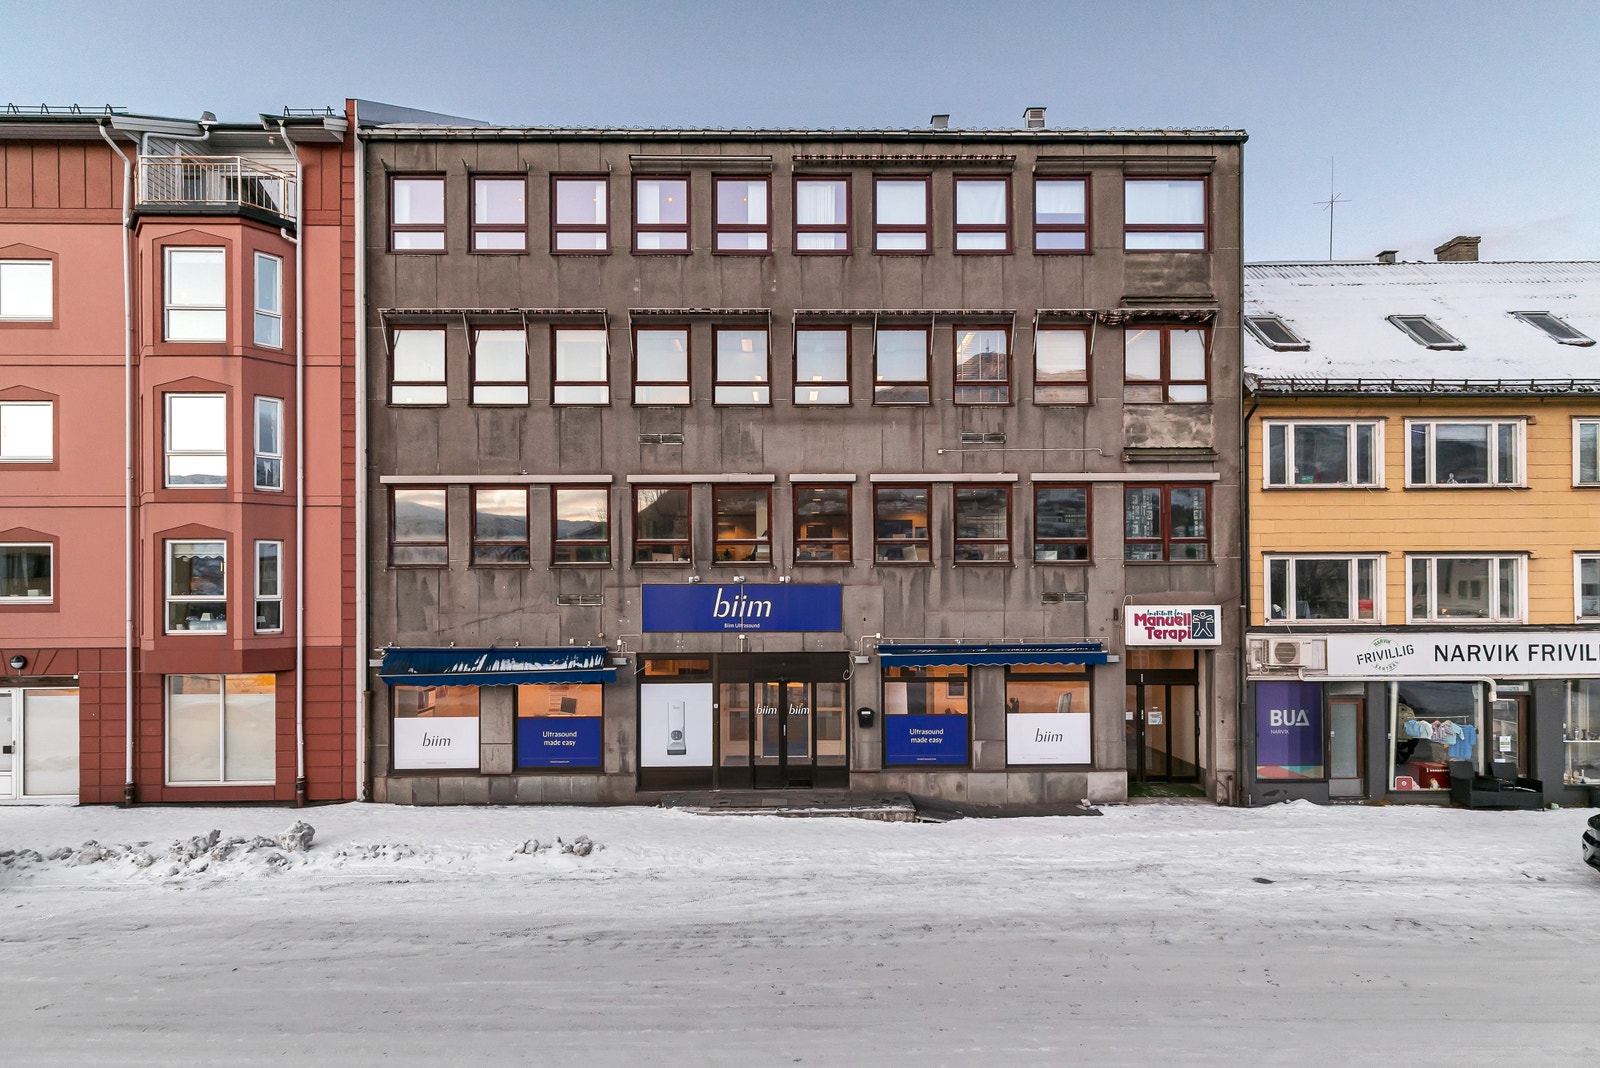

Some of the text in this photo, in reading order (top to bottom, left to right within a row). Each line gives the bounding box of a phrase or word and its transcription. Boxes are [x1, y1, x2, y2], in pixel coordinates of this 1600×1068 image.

[713, 587, 772, 618] biim
[1134, 613, 1191, 627] Manuell
[1145, 626, 1191, 642] Terapi
[1356, 644, 1415, 665] FRIVILLIG
[1434, 644, 1600, 662] NARVIK FRIVIL
[756, 703, 777, 715] biim
[788, 703, 810, 715] biim
[1270, 709, 1310, 727] BUA
[422, 732, 451, 747] biim
[1035, 727, 1063, 742] biim
